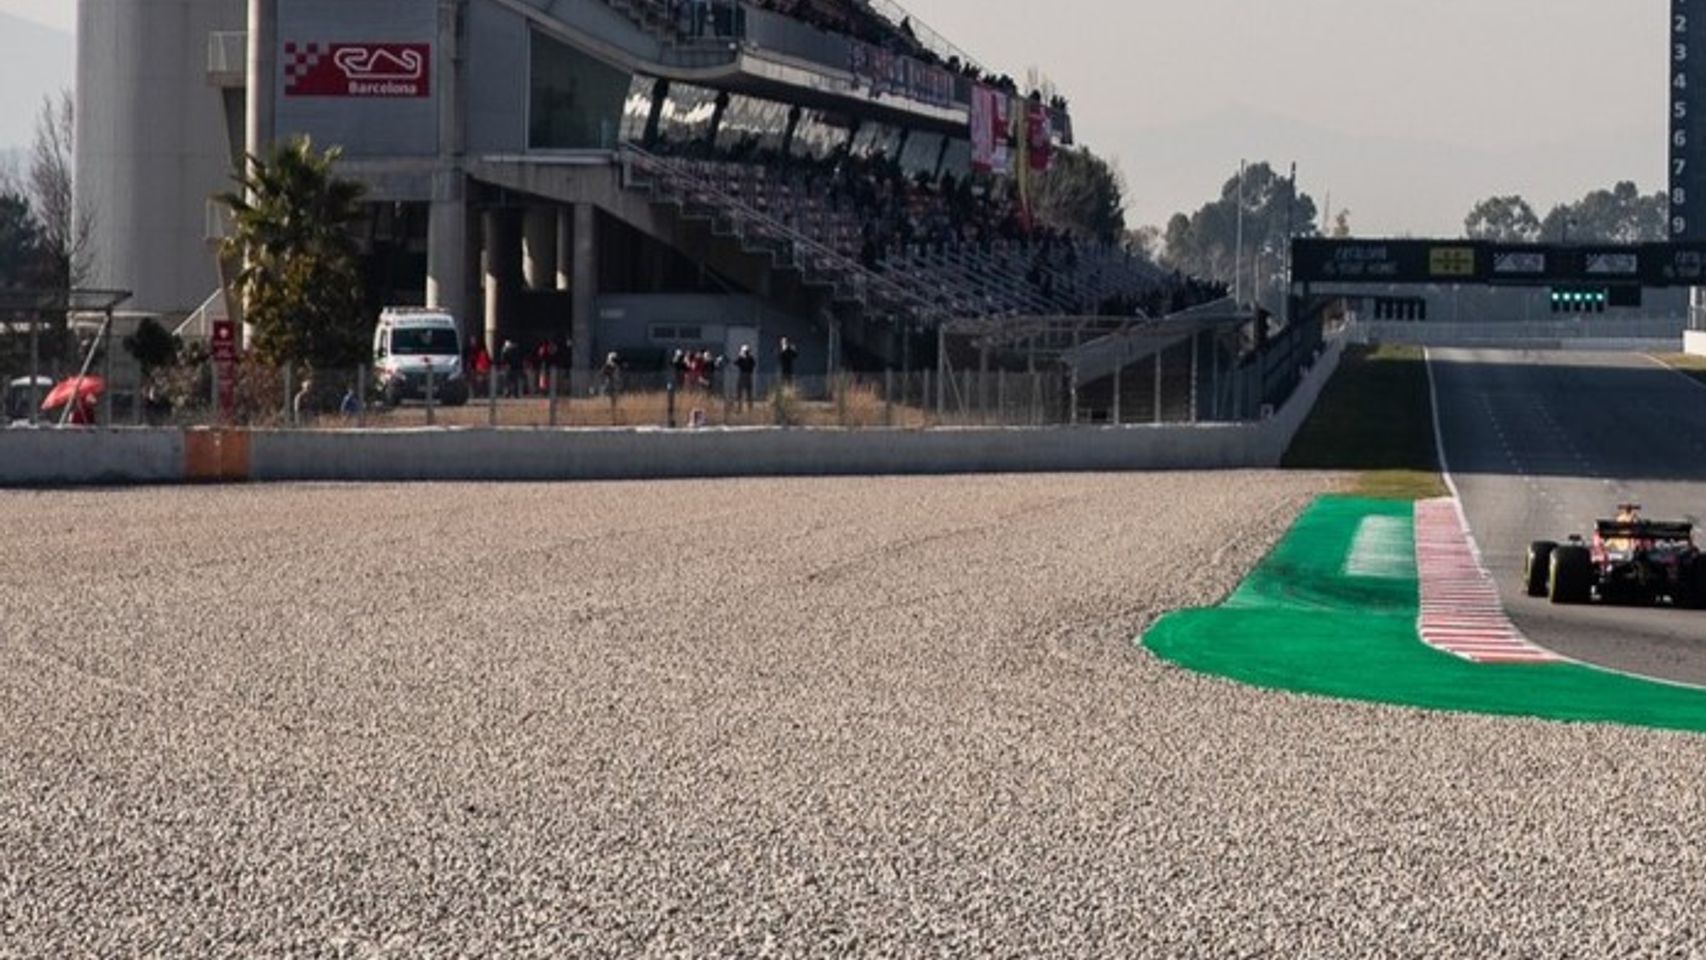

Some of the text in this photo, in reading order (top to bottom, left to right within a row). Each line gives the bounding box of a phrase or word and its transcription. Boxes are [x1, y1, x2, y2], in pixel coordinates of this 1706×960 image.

[1673, 14, 1687, 32] 2
[1674, 44, 1687, 60] 3
[349, 82, 417, 94] Barcelona
[1673, 73, 1687, 88] 4
[1674, 102, 1687, 118] 5
[1673, 130, 1687, 146] 6
[1673, 159, 1686, 174] 7
[1672, 188, 1686, 204] 8
[1672, 217, 1686, 233] 9
